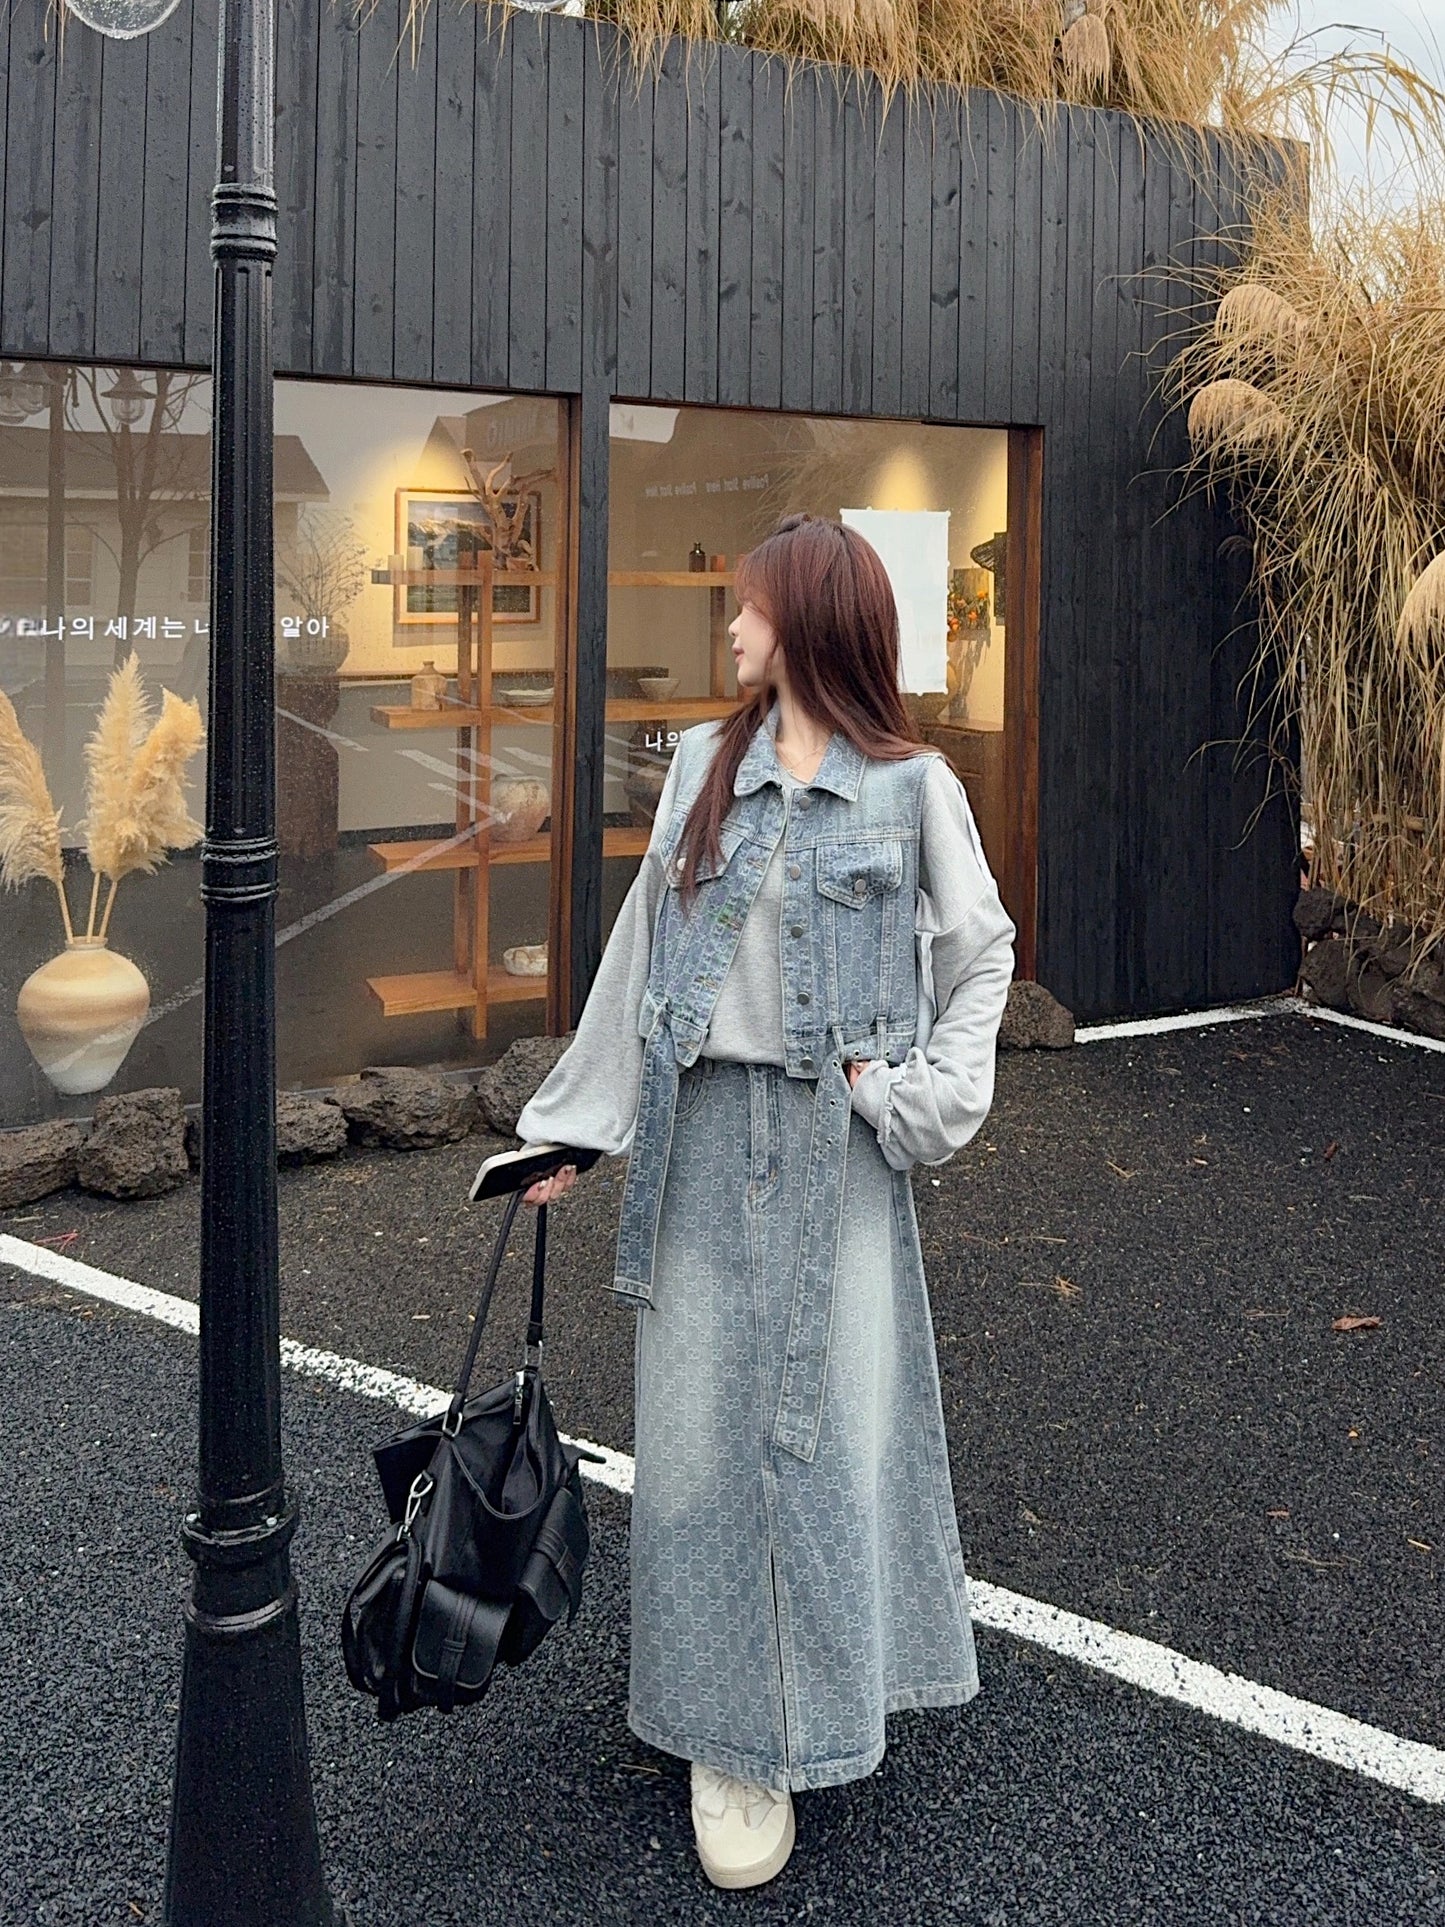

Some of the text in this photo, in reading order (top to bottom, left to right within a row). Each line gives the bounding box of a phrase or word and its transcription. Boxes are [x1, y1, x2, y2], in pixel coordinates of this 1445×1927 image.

[42, 616, 94, 641] 나의
[103, 615, 187, 641] 세계는
[280, 616, 330, 639] 알아
